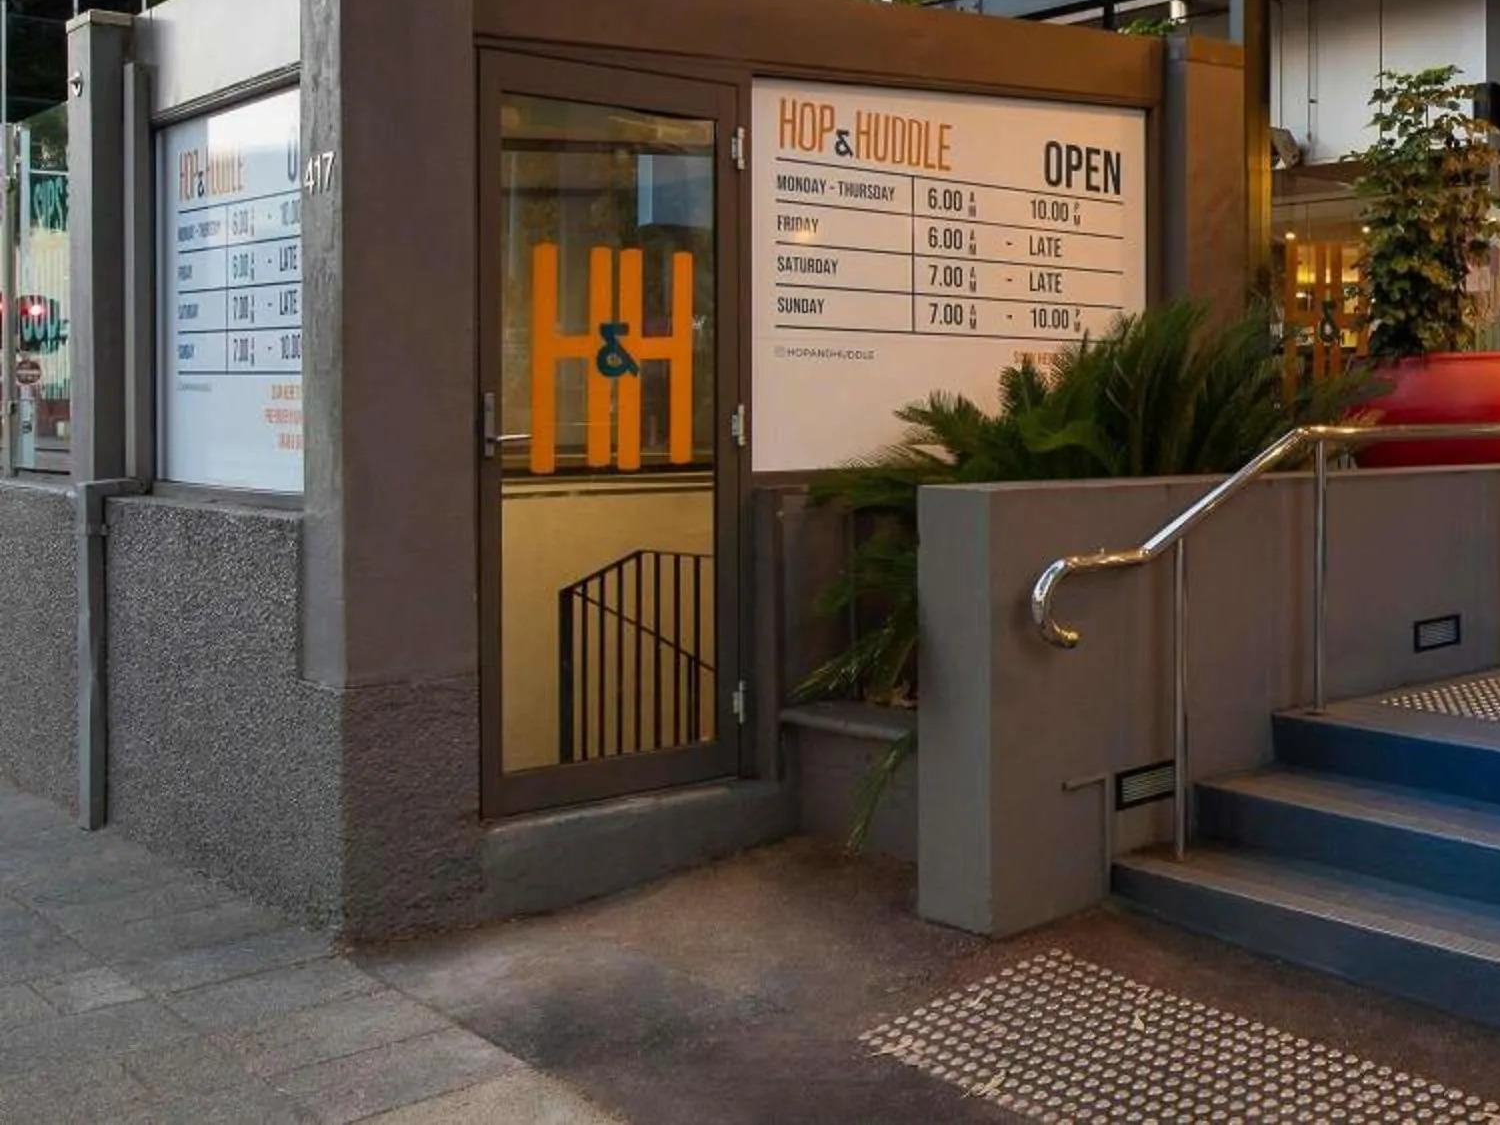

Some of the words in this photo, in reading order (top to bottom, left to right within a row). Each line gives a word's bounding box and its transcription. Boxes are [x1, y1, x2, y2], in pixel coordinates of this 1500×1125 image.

[303, 150, 336, 196] 417
[1043, 140, 1121, 196] OPEN
[776, 174, 827, 196] MONDAY
[838, 180, 896, 202] THURSDAY
[927, 187, 963, 212] 6.00
[1030, 199, 1069, 222] 10.00
[776, 214, 819, 235] FRIDAY
[927, 226, 963, 250] 6.00
[1029, 234, 1063, 258] LATE
[776, 255, 839, 276] SATURDAY
[928, 264, 963, 288] 7.00
[1029, 271, 1063, 294] LATE
[776, 295, 825, 315] SUNDAY
[928, 303, 964, 326] 7.00
[1030, 307, 1070, 330] 10.00
